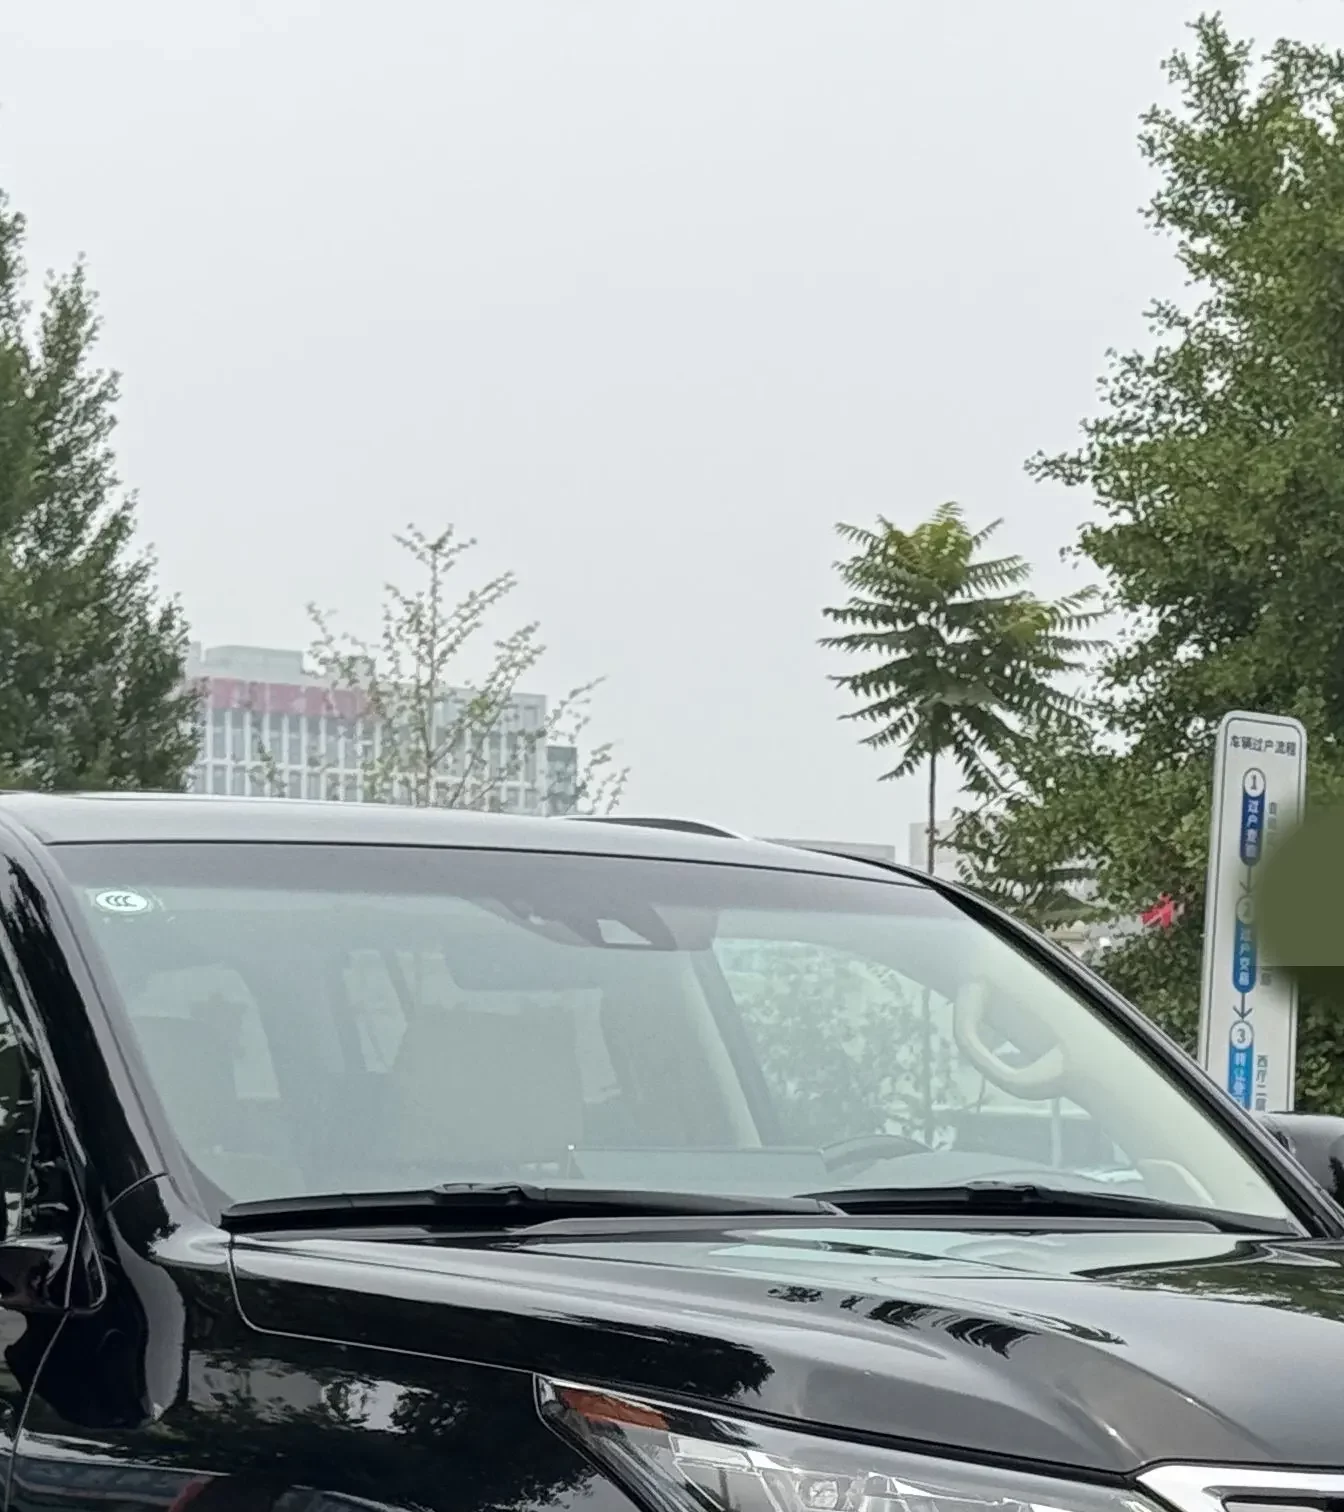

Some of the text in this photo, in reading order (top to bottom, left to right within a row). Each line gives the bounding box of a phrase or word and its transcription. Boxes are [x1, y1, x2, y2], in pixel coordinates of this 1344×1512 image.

[1230, 735, 1297, 756] 车辆过户流程
[1236, 1028, 1247, 1044] 3
